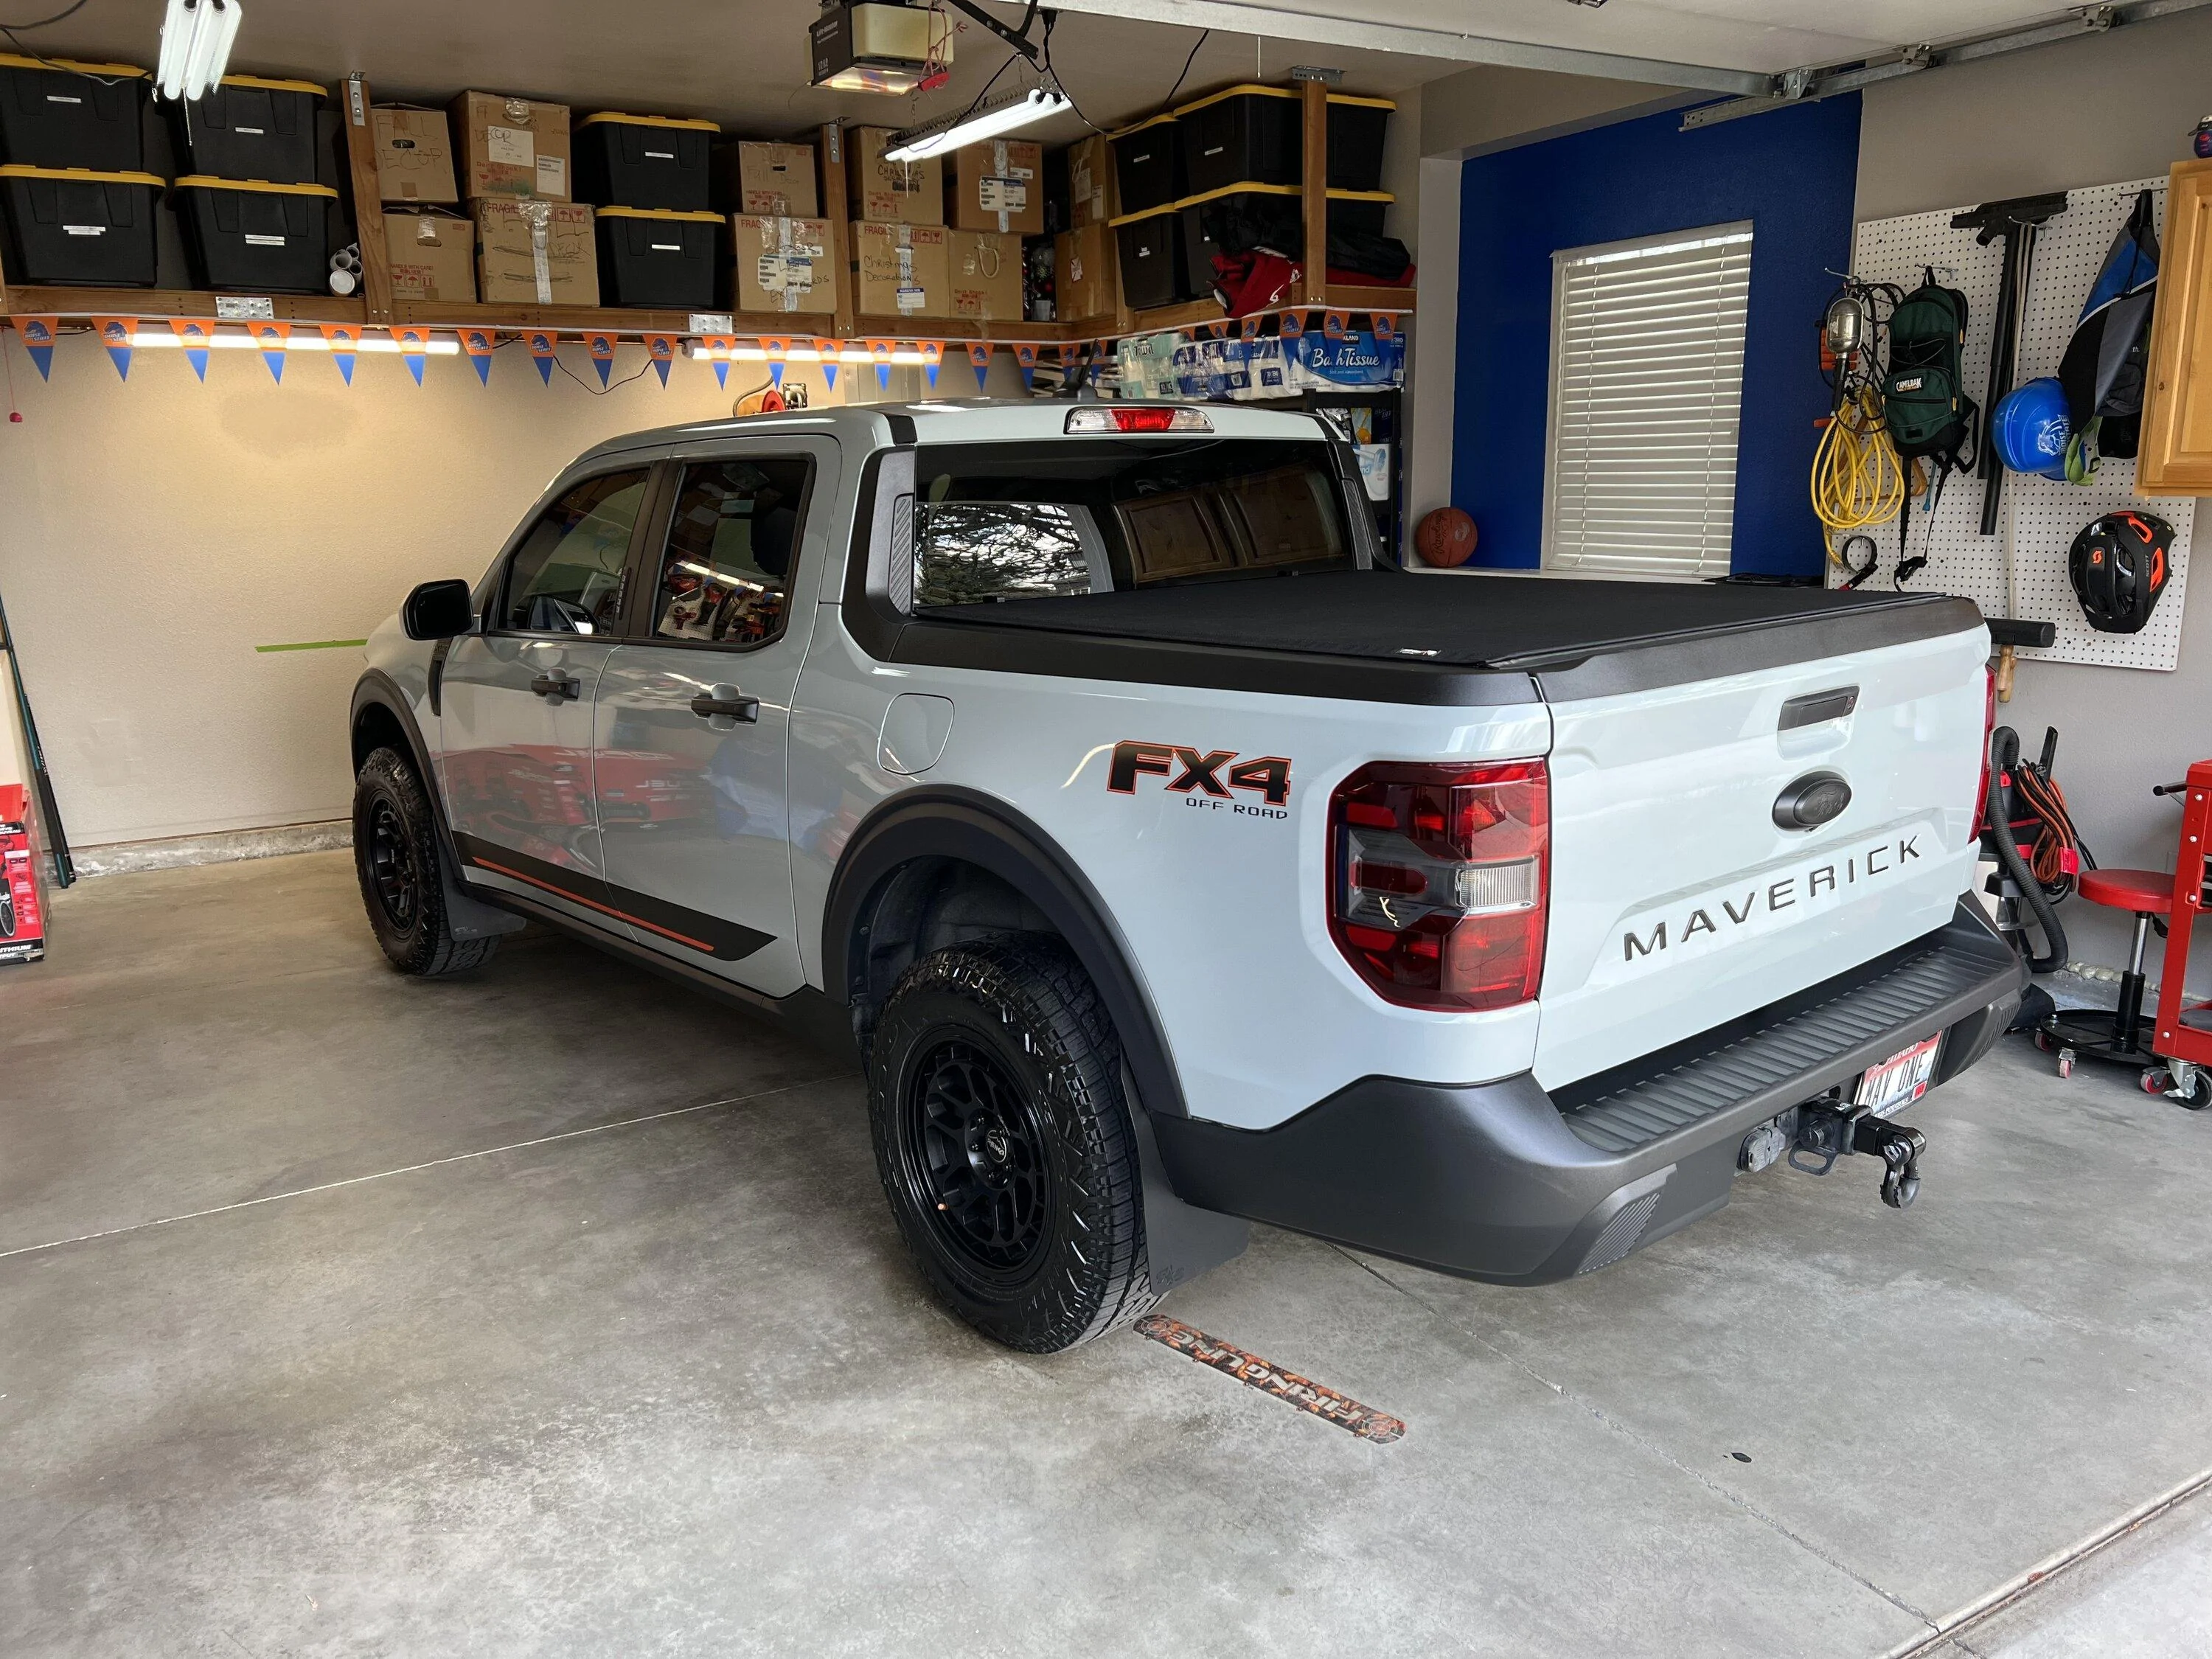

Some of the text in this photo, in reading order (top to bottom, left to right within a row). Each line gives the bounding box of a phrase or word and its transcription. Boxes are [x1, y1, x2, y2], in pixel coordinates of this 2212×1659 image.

[487, 204, 521, 214] FRAGIL
[1312, 347, 1380, 368] Bah Tissue
[1896, 378, 1922, 392] CAMELBAK
[1107, 740, 1292, 807] FX4
[1186, 797, 1288, 819] OFF ROAD
[1624, 835, 1920, 961] MAVERICK
[1898, 1050, 1928, 1093] ONE
